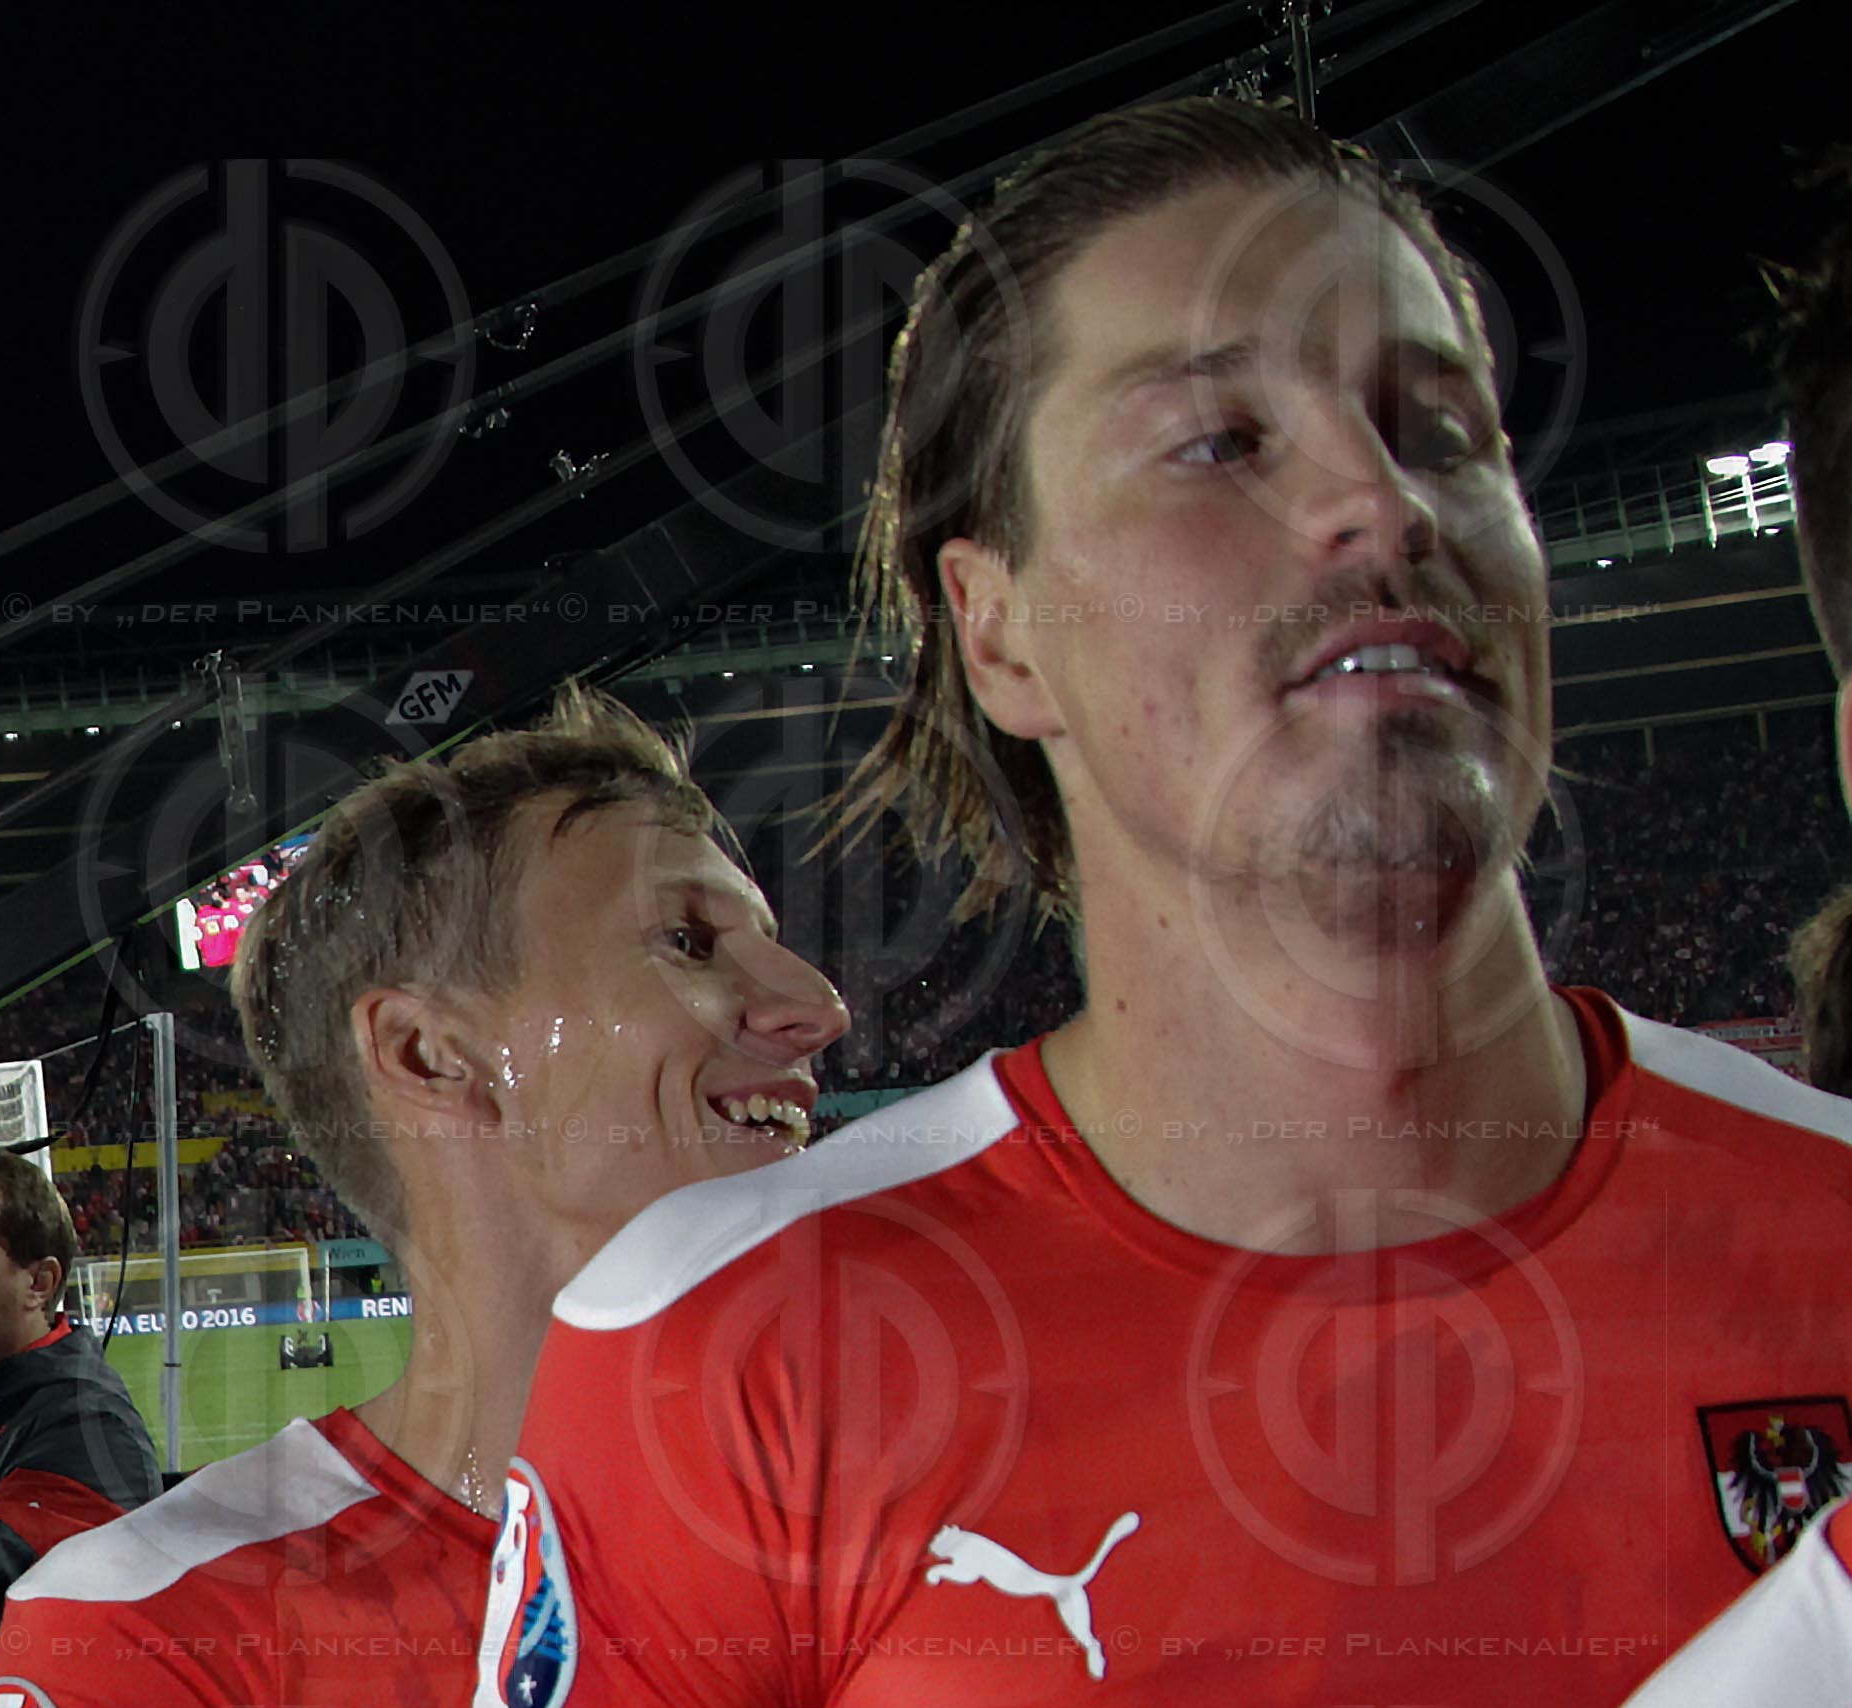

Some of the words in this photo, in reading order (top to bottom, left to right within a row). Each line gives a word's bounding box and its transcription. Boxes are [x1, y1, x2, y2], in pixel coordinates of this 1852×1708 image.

[396, 672, 462, 724] GFM
[202, 1307, 256, 1328] 2016
[361, 1296, 413, 1318] REN
